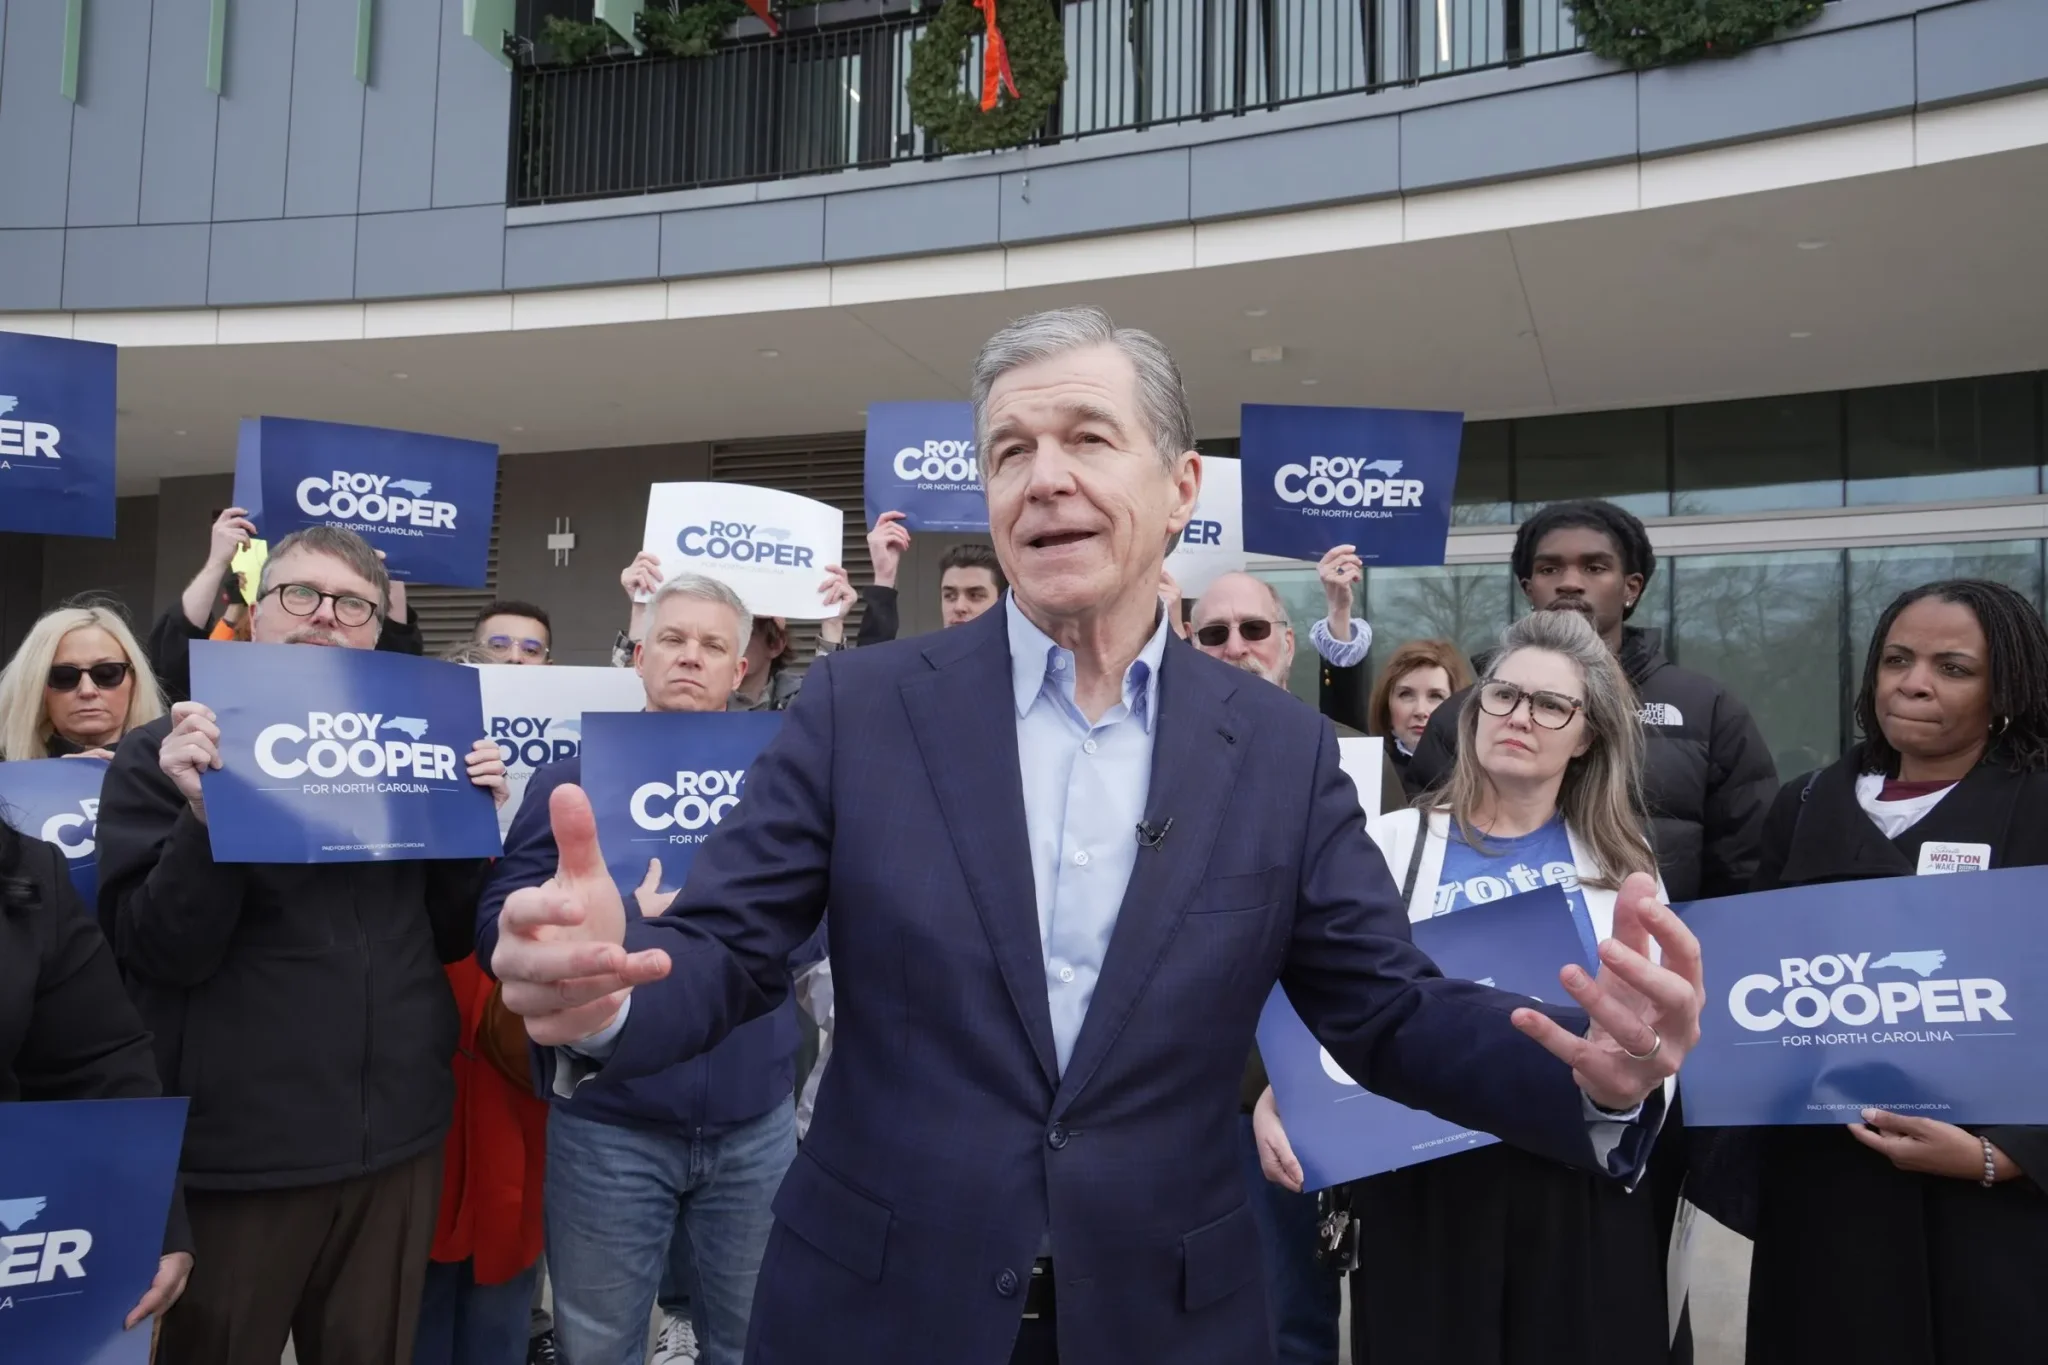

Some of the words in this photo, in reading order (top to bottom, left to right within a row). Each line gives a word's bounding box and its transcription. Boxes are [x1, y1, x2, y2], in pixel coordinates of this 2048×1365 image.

[924, 440, 970, 458] ROY
[1309, 456, 1367, 478] ROY
[332, 470, 391, 495] ROY
[1274, 463, 1424, 507] COOPER
[296, 476, 458, 529] COOPER
[1302, 508, 1320, 516] FOR
[1321, 509, 1352, 518] NORTH
[1354, 510, 1393, 518] CAROLINA
[325, 520, 344, 529] FOR
[344, 522, 376, 533] NORTH
[377, 525, 424, 537] CAROLINA
[709, 521, 757, 540] ROY
[677, 525, 814, 568] COOPER
[1637, 709, 1664, 718] ORTH
[1644, 702, 1664, 710] THE
[308, 711, 383, 739] ROY
[491, 717, 552, 738] ROY
[254, 723, 458, 781] COOPER
[494, 738, 581, 767] OOP
[303, 784, 329, 794] FOR
[332, 783, 374, 794] NORTH
[377, 783, 429, 793] CAROLINA
[676, 770, 745, 795] ROY
[670, 835, 692, 844] FOR
[1930, 854, 1981, 864] WALTON
[1935, 863, 1955, 871] WAKE
[1780, 952, 1871, 987] ROY
[1728, 973, 2014, 1032] COOPER
[1782, 1035, 1811, 1047] FOR
[1815, 1033, 1868, 1045] NORTH
[1871, 1030, 1954, 1043] CAROLINA
